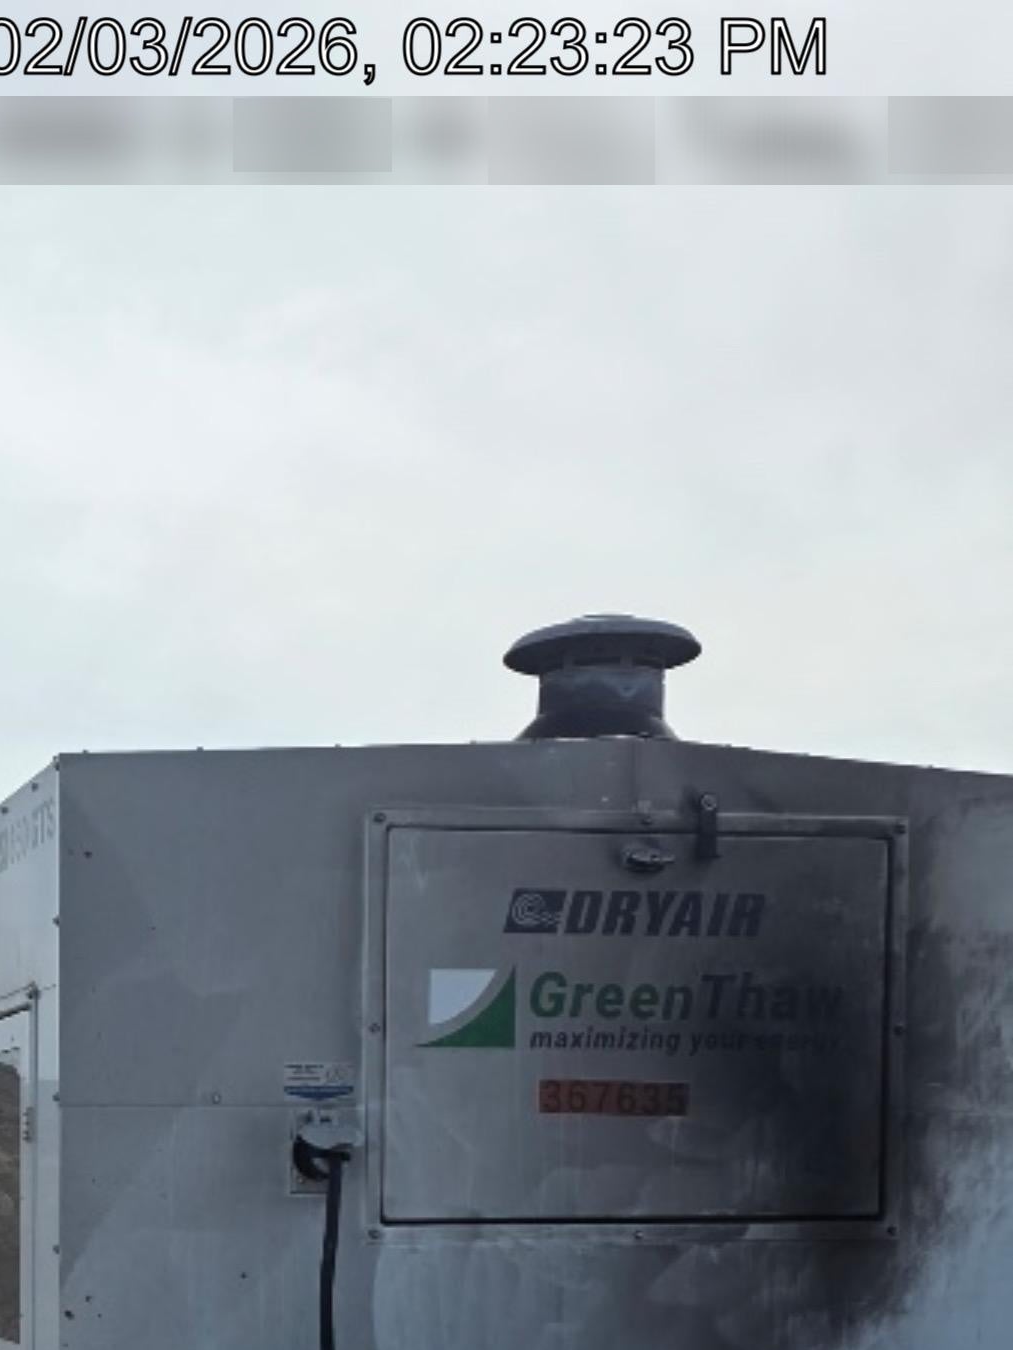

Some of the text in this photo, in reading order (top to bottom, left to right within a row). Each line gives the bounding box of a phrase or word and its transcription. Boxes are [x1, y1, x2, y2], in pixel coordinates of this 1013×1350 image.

[564, 889, 766, 938] DRYAIR
[529, 1026, 682, 1054] maximizing
[689, 1032, 745, 1056] your
